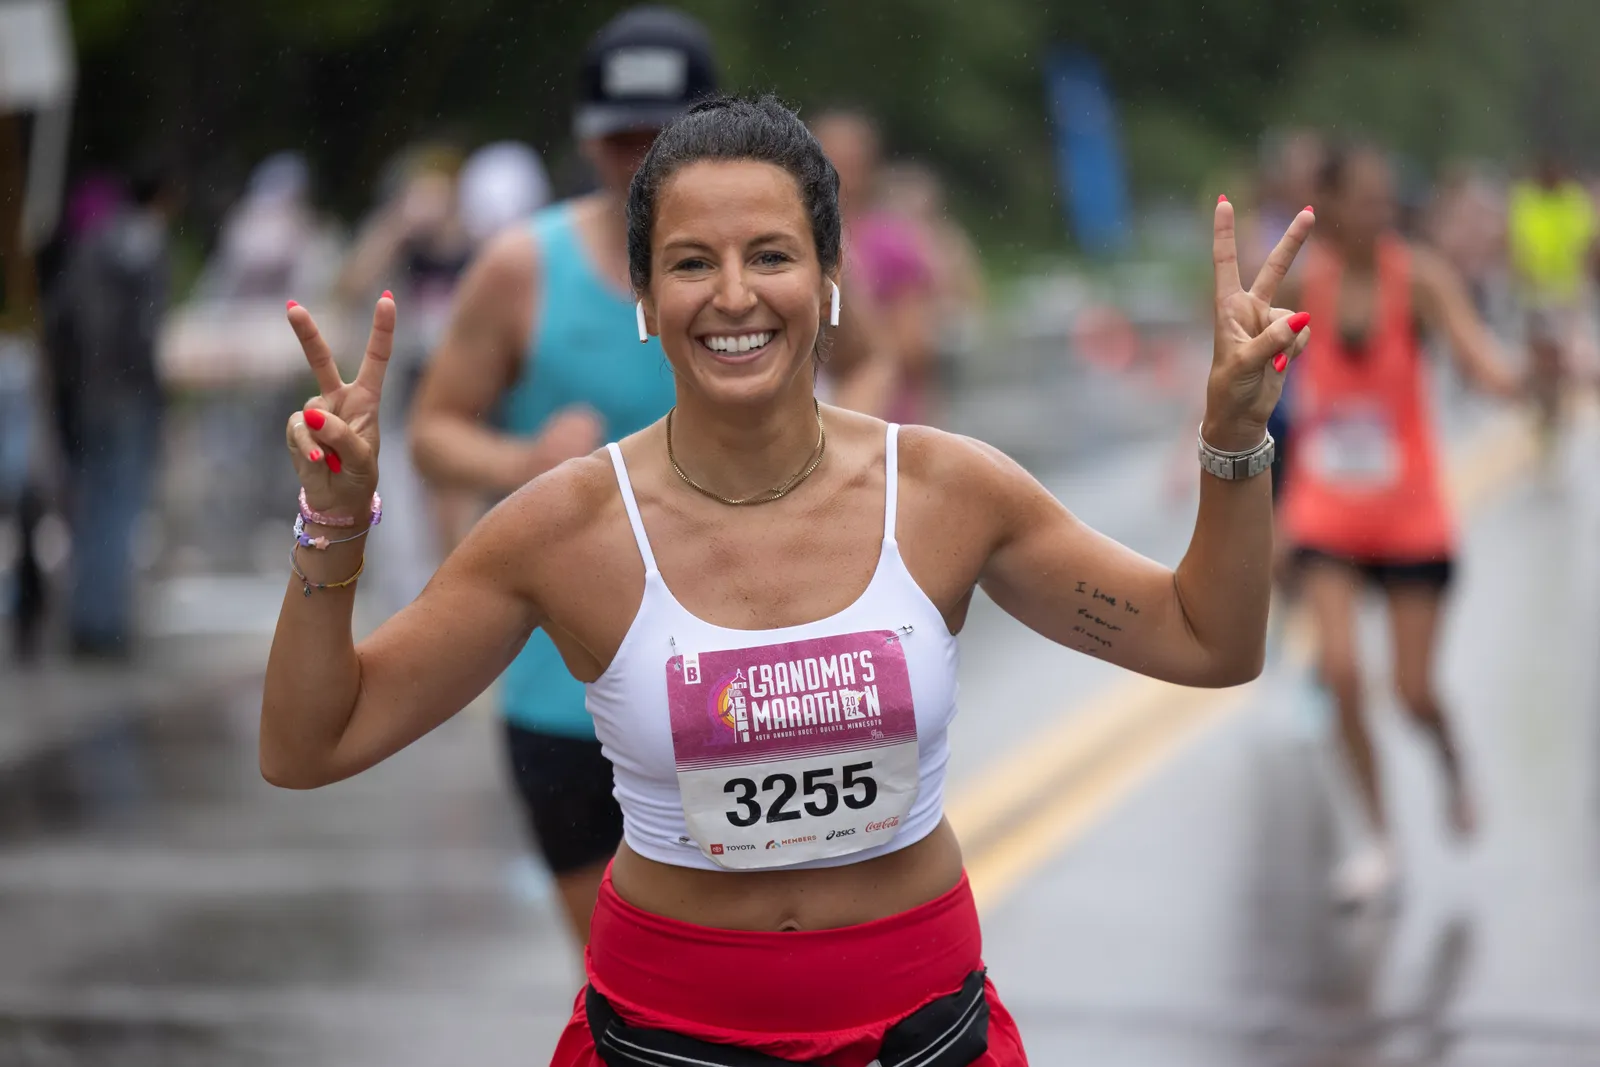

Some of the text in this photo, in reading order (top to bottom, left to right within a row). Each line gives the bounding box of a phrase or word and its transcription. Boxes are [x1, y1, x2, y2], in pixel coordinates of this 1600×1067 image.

[1074, 581, 1086, 593] I
[1125, 599, 1140, 614] You
[686, 666, 698, 681] B
[748, 650, 875, 698] GRANDMA'S
[751, 684, 881, 732] MARATHN
[845, 695, 856, 707] 20
[846, 706, 858, 717] 24
[847, 719, 882, 730] MINNESOTA
[723, 761, 878, 827] 3255
[726, 843, 757, 852] TOYOTA
[781, 834, 817, 846] MEMBERS
